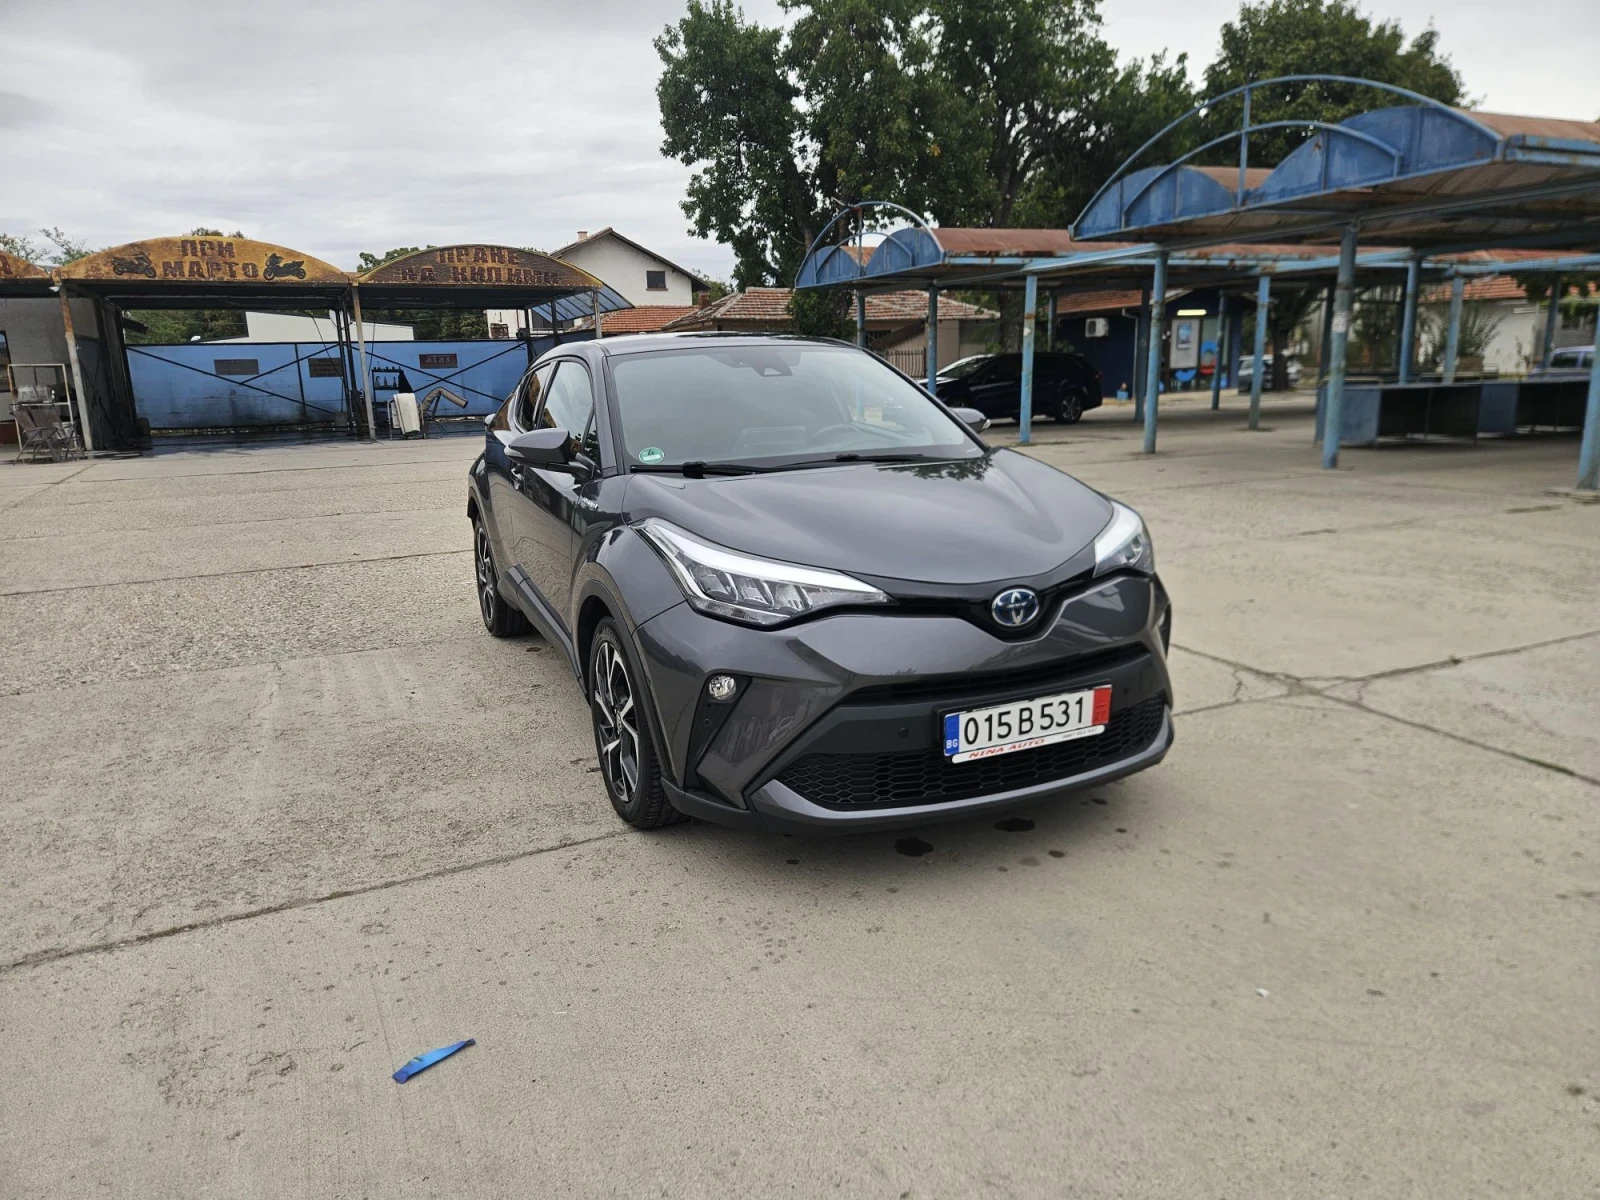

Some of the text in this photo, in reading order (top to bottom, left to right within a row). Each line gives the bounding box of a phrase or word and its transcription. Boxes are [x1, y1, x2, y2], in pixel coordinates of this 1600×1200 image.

[181, 239, 234, 258] ПРИ
[438, 247, 521, 265] ПРАНЕ
[162, 260, 259, 278] МАРТО
[402, 266, 436, 281] НА
[964, 697, 1083, 745] 015B531
[946, 738, 958, 749] BG
[968, 738, 1045, 758] NINA AUTO
